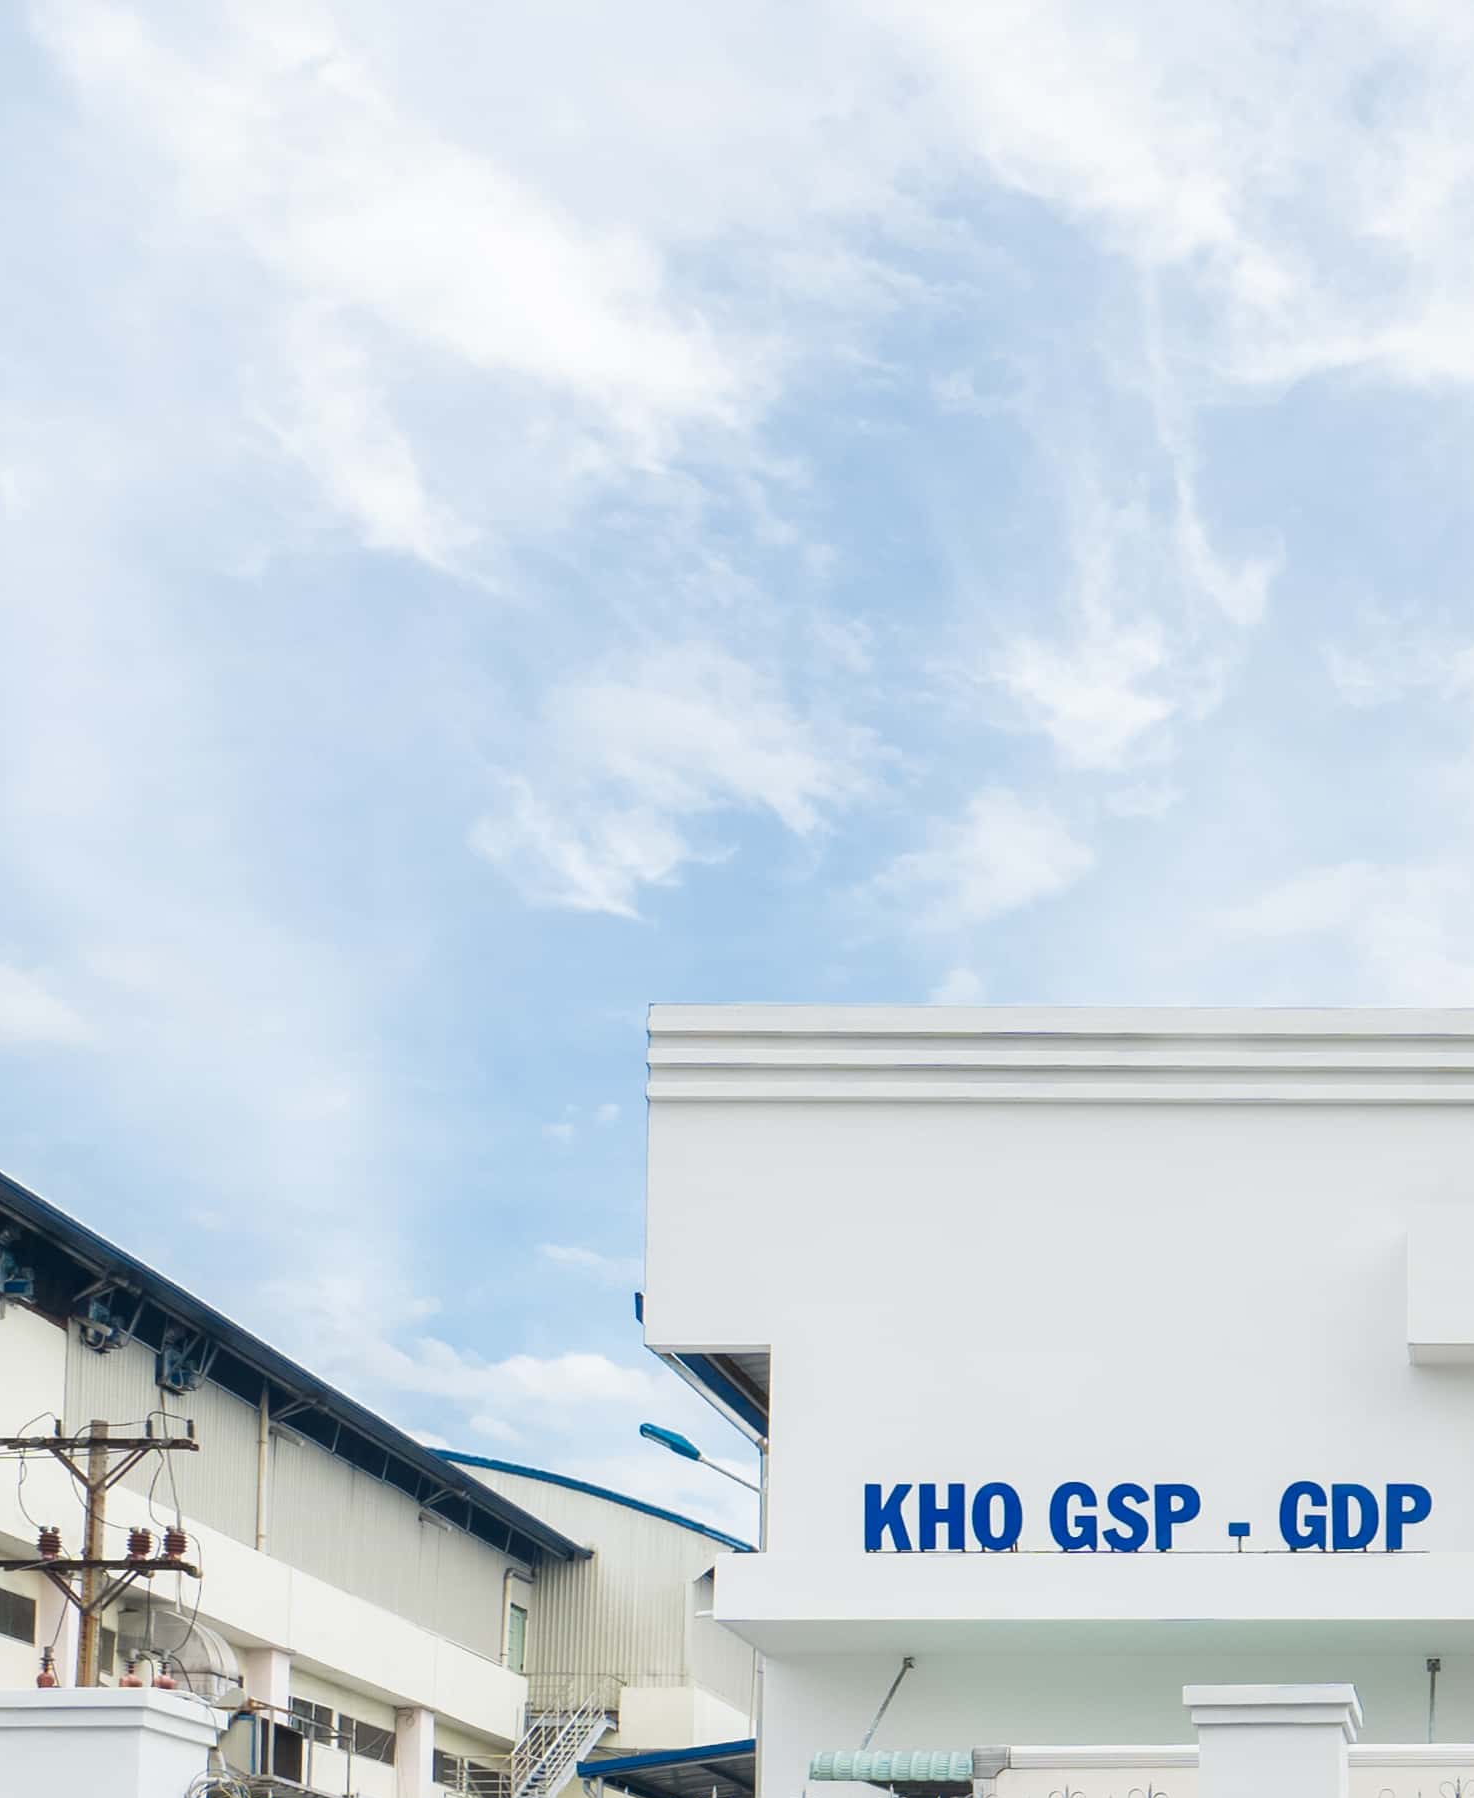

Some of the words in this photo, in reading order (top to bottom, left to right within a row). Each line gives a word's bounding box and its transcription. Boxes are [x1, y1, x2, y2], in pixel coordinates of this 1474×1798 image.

[865, 1481, 1023, 1552] KHO
[1049, 1481, 1201, 1552] GSP
[1279, 1480, 1433, 1551] GDP
